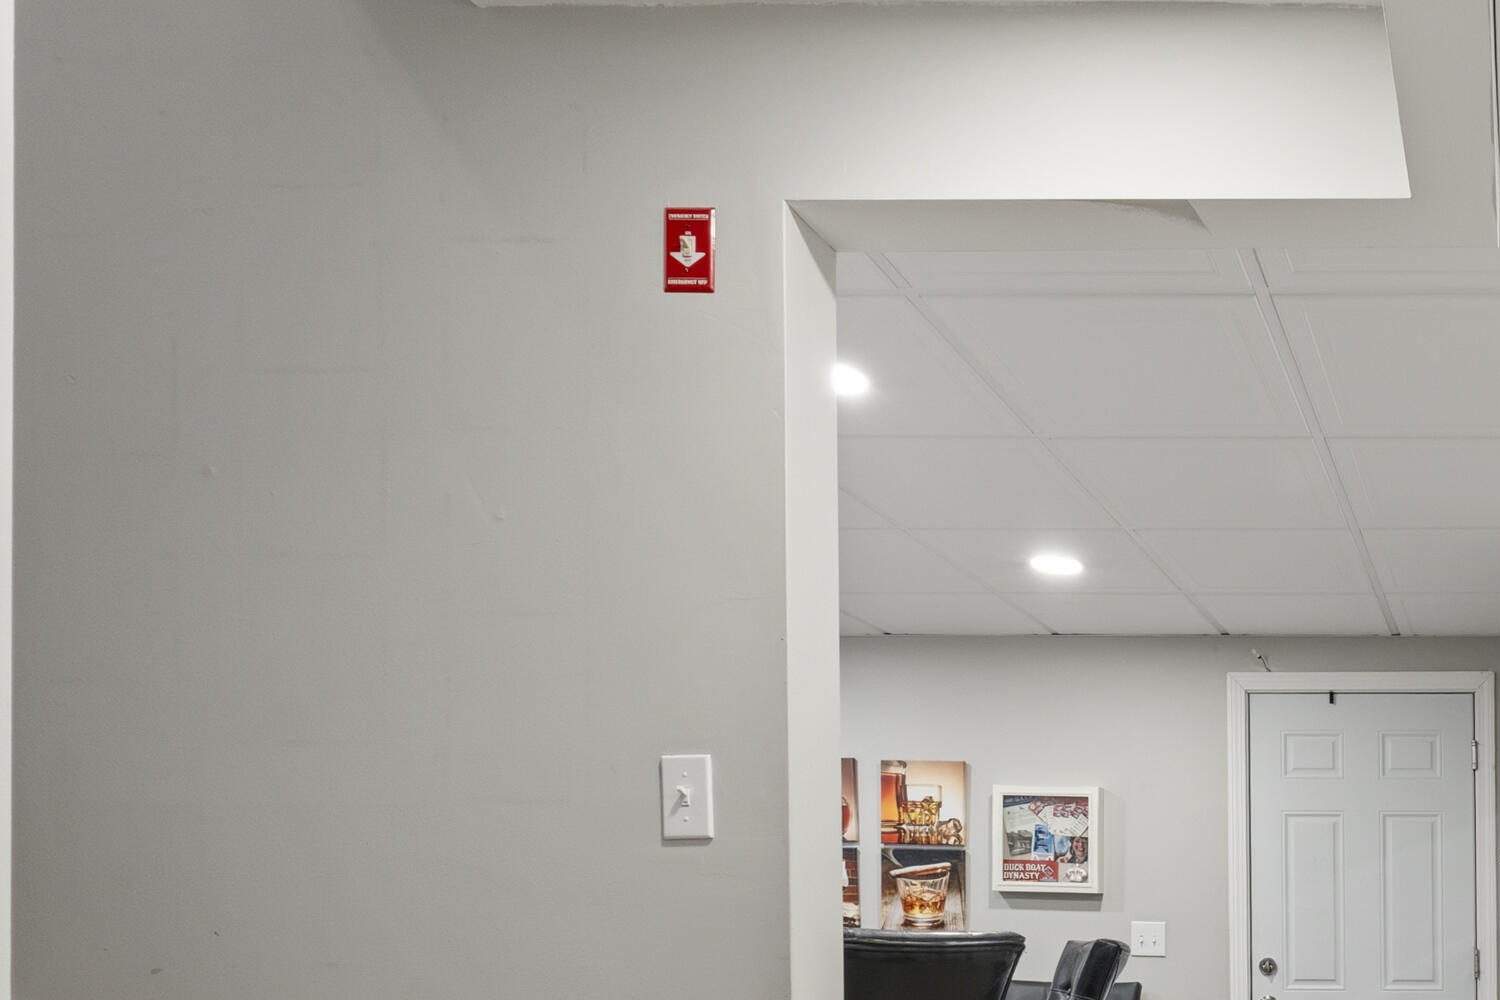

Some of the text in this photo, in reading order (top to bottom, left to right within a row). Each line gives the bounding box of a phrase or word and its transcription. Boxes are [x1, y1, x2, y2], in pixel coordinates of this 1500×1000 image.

[1003, 863, 1047, 872] DUCK BOAT
[1003, 871, 1040, 880] DYNASTY
